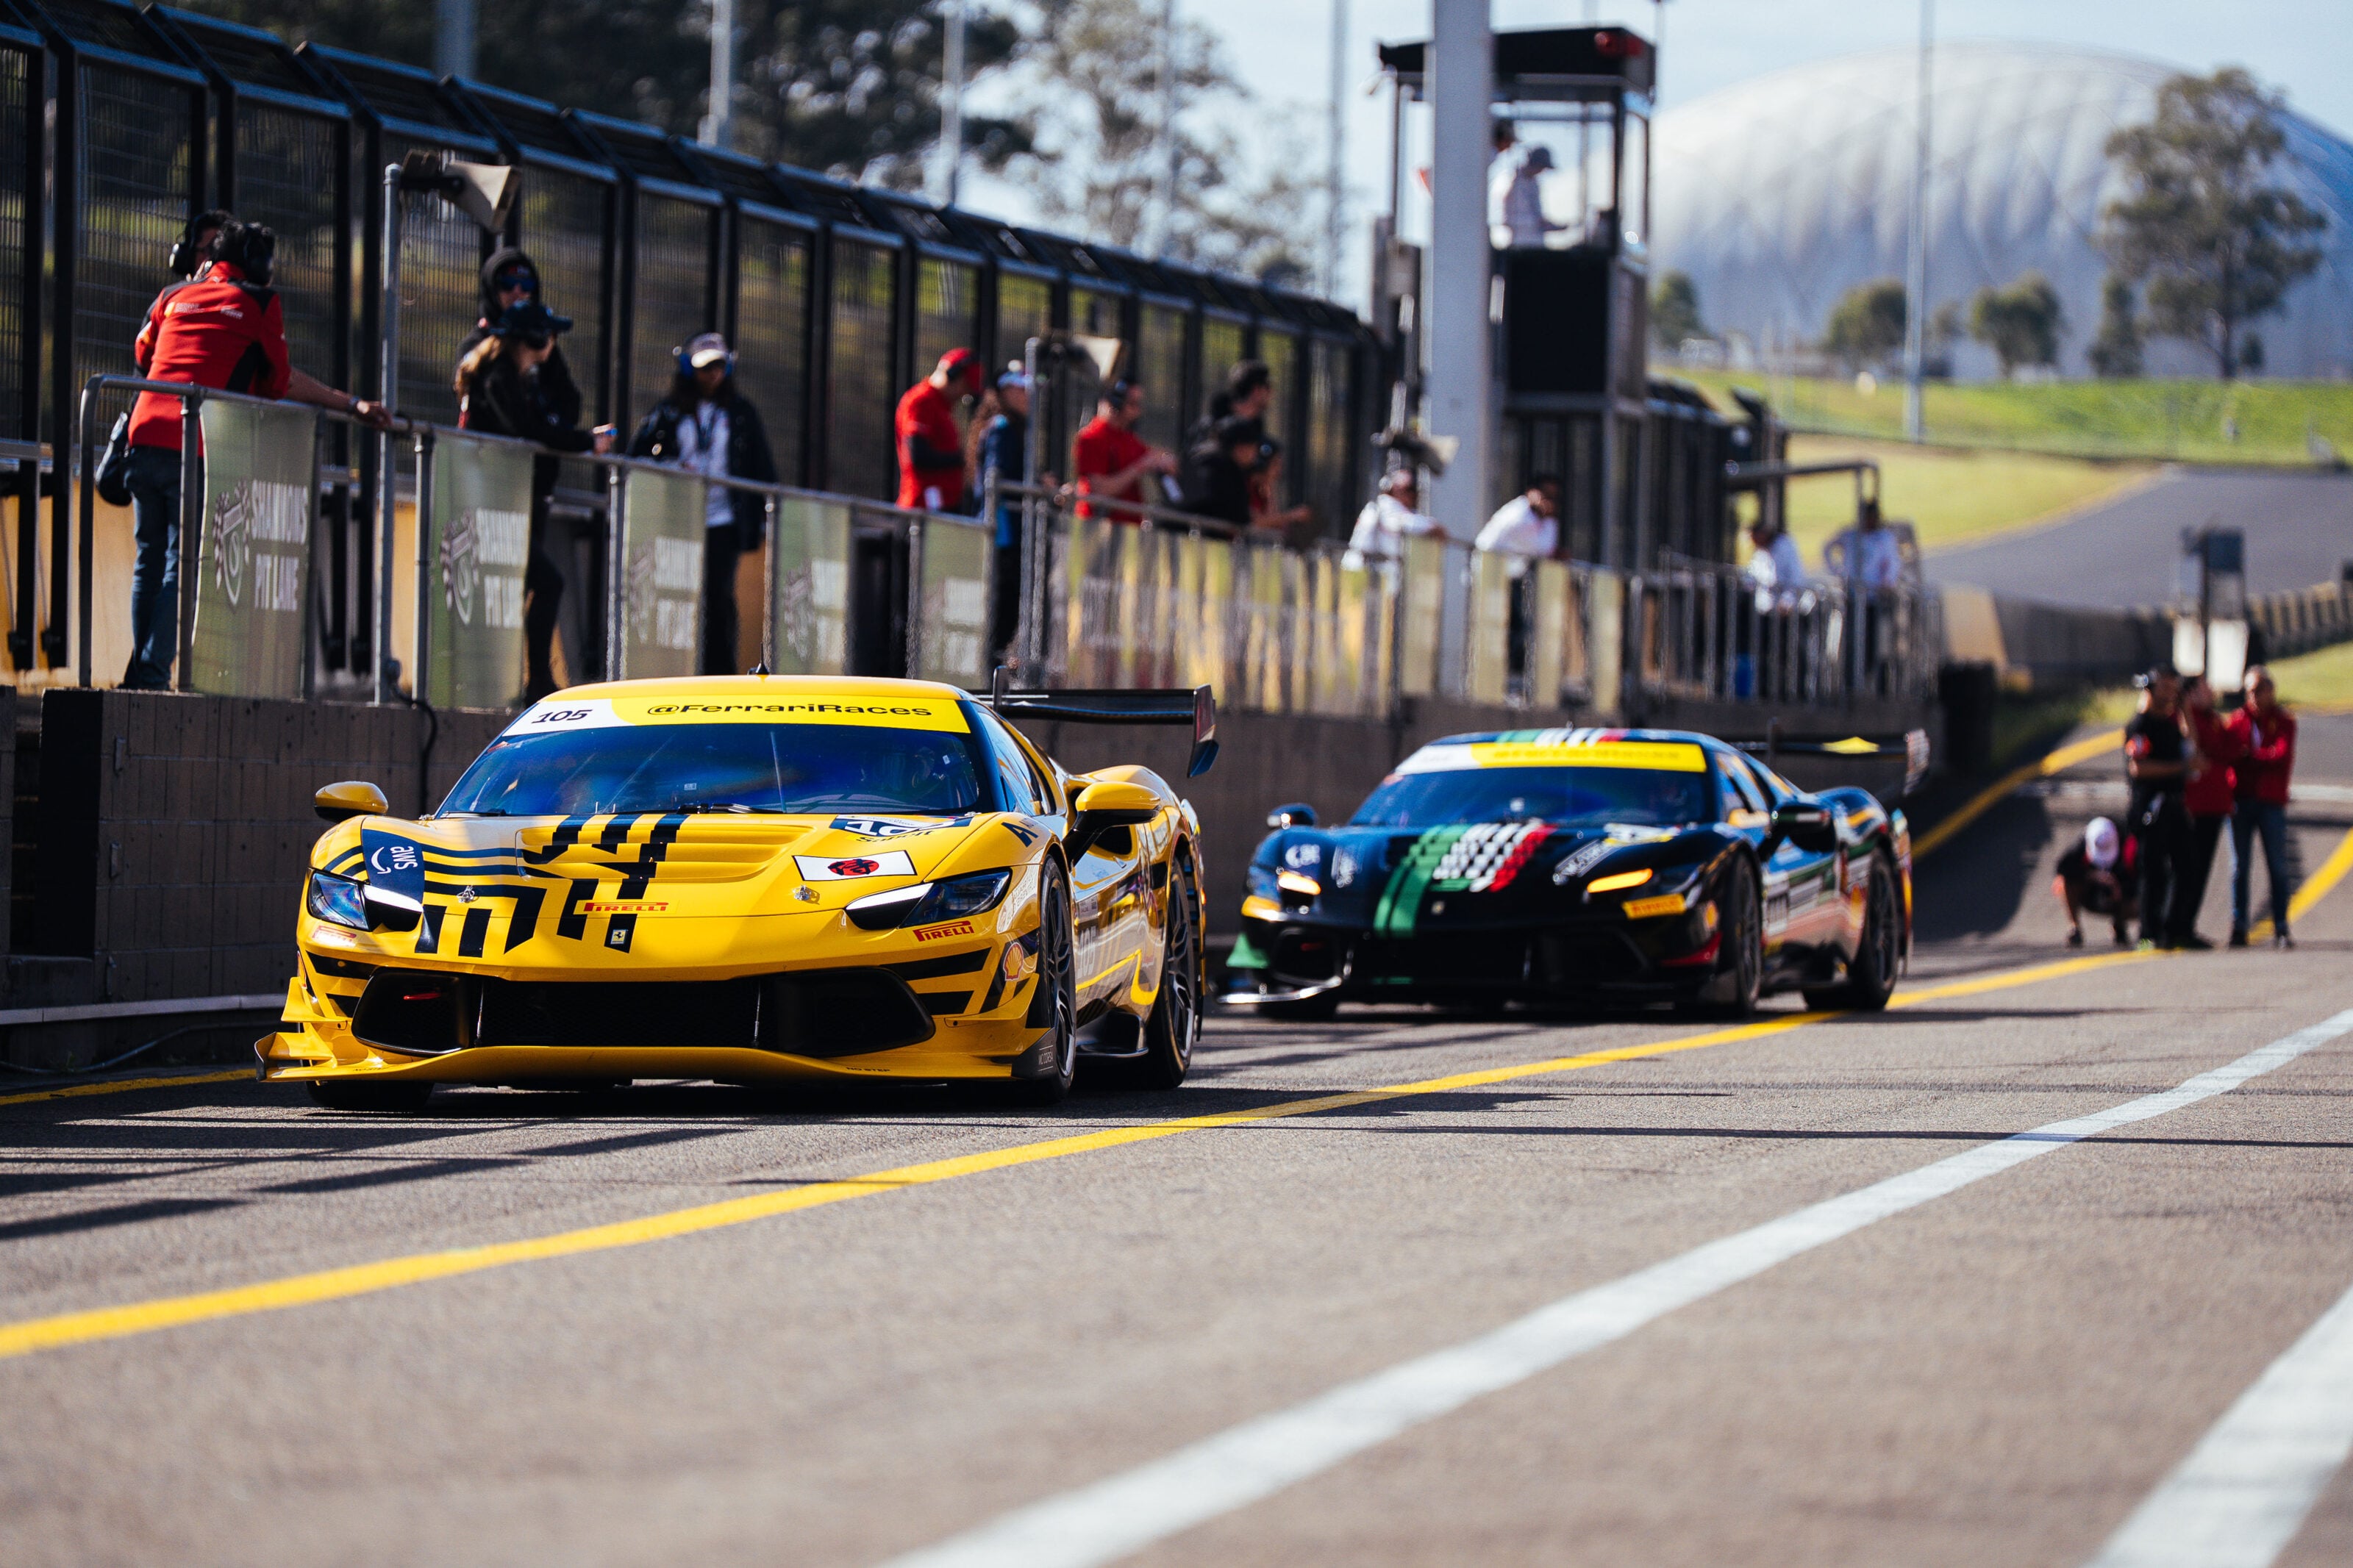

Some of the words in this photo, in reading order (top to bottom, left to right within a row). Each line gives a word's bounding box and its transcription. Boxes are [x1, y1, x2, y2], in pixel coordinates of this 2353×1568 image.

[254, 554, 272, 609] PIT
[531, 709, 593, 724] 105
[647, 704, 932, 716] @FerrariRaces
[390, 846, 418, 870] aws
[583, 902, 668, 912] PIRELLI
[913, 920, 974, 942] PIRELLI
